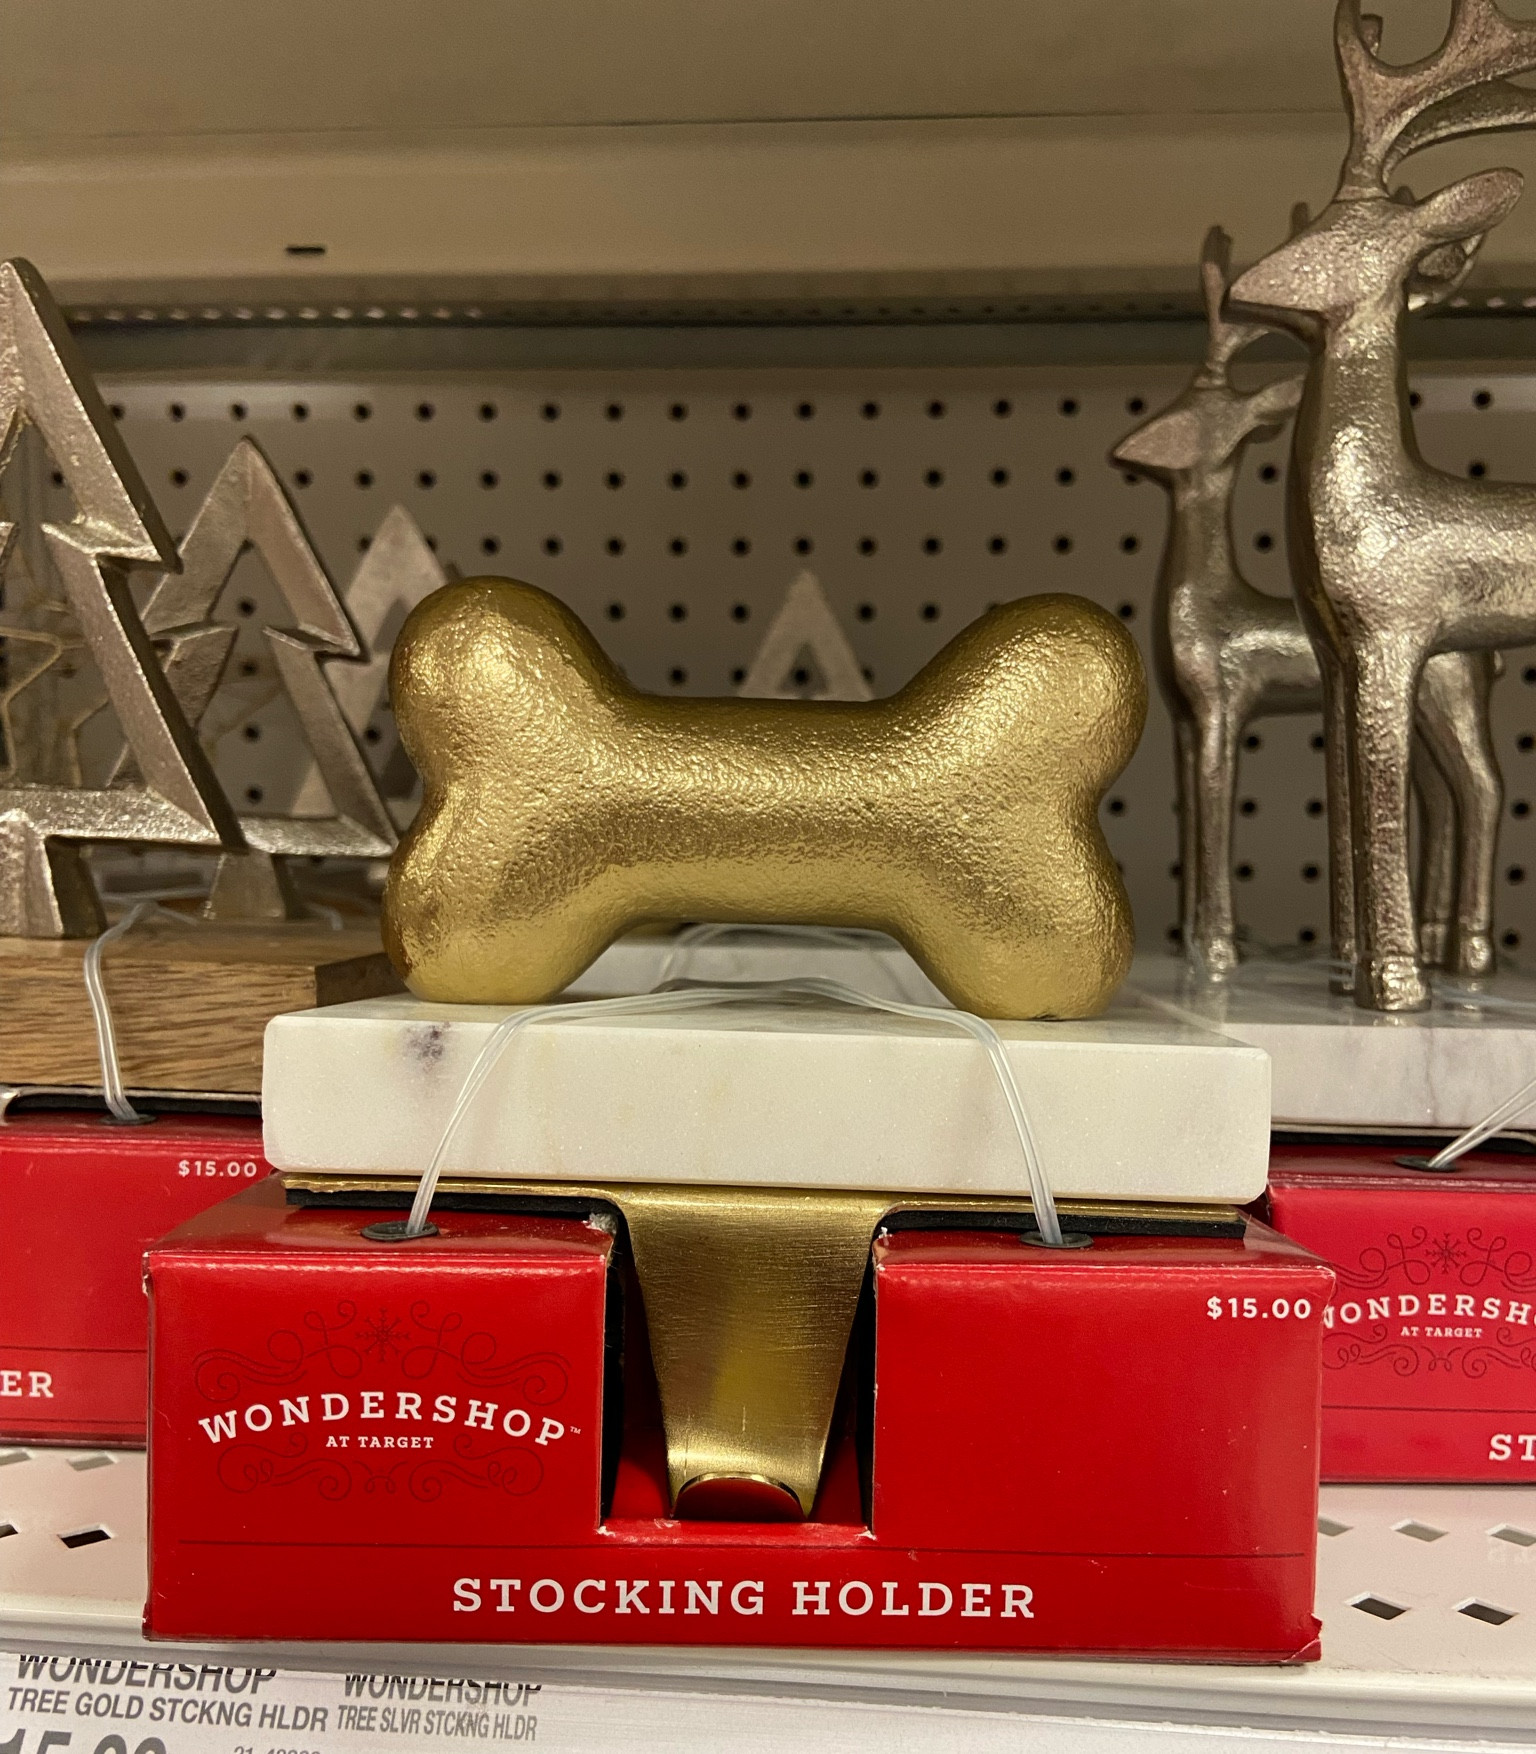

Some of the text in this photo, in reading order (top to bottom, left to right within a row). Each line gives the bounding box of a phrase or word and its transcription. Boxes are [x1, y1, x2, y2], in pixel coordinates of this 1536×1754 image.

[178, 1160, 258, 1178] $15.00
[1206, 1296, 1311, 1320] $15.00
[1323, 1293, 1536, 1329] ONDERSH
[1401, 1326, 1483, 1338] AT TARGET
[0, 1370, 54, 1398] ER
[198, 1391, 565, 1446] WONDERSHOP
[325, 1435, 434, 1449] AT TARGET
[1488, 1434, 1536, 1462] ST
[452, 1577, 1035, 1619] STOCKING HOLDER
[17, 1655, 277, 1694] WONDERSHOP
[344, 1675, 542, 1707] WONDERSHOP
[8, 1687, 329, 1732] TREE GOLD STCKNG HLDR
[337, 1704, 538, 1741] TREE SLVR STCKNG HLDR
